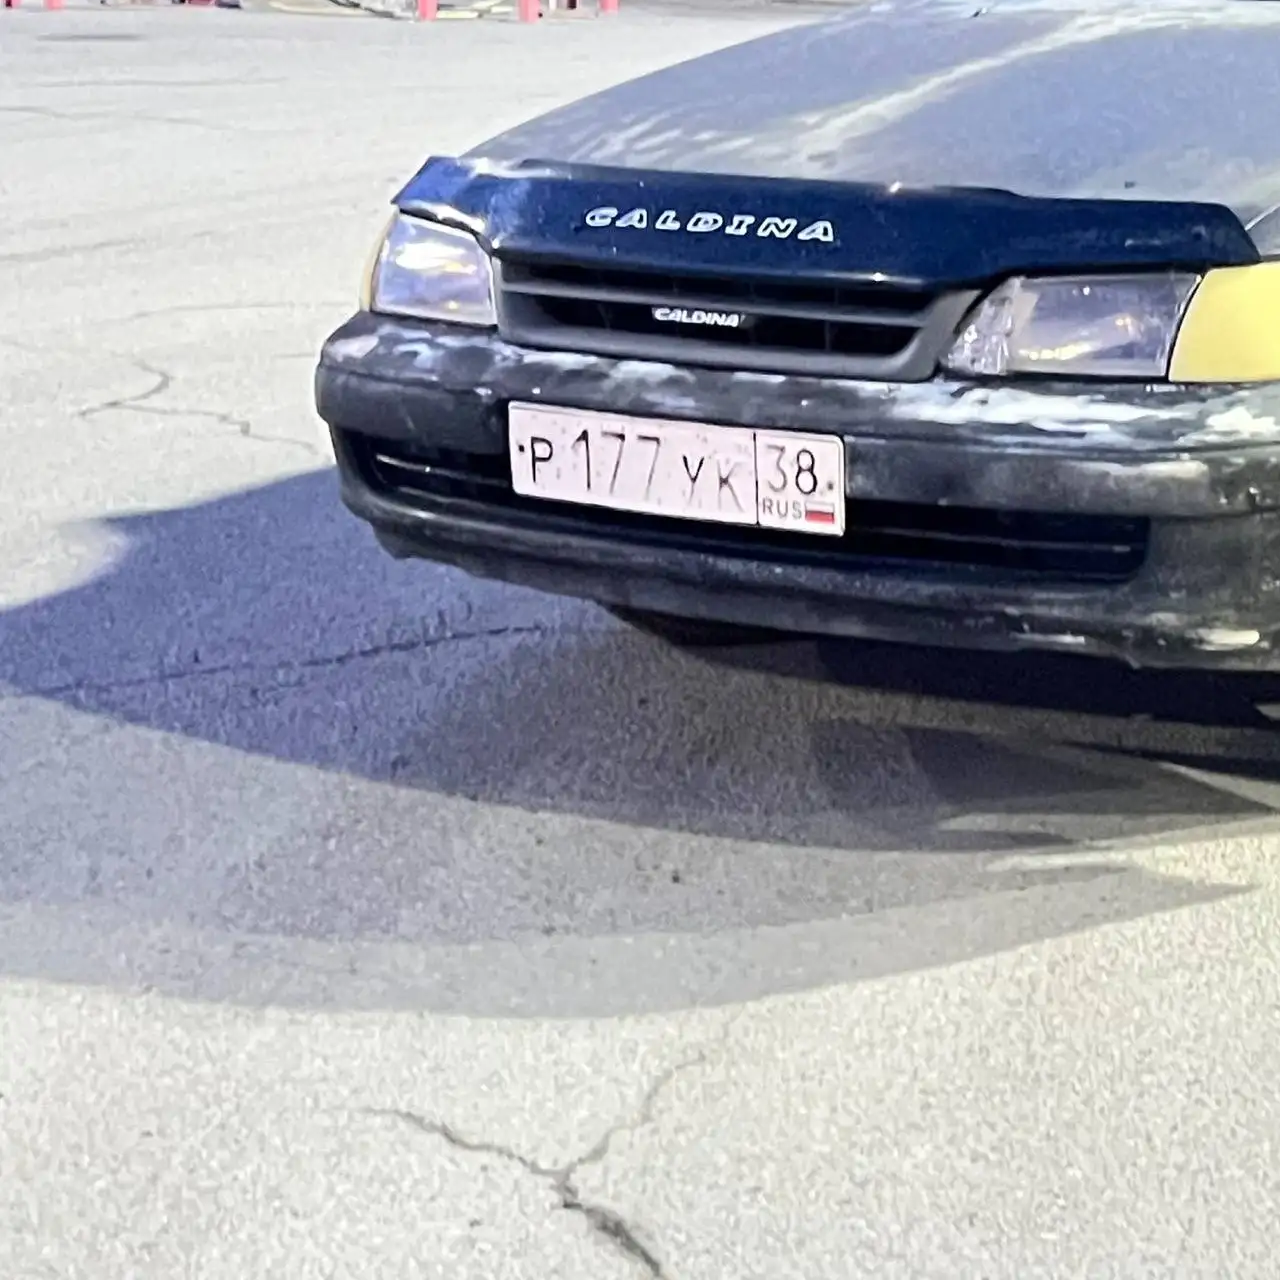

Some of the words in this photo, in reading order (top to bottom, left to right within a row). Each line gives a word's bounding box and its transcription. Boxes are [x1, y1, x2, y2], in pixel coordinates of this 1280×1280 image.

[585, 207, 834, 242] CALDINA
[654, 308, 738, 327] CALDINA
[767, 444, 818, 494] 38
[762, 498, 802, 520] RUS
